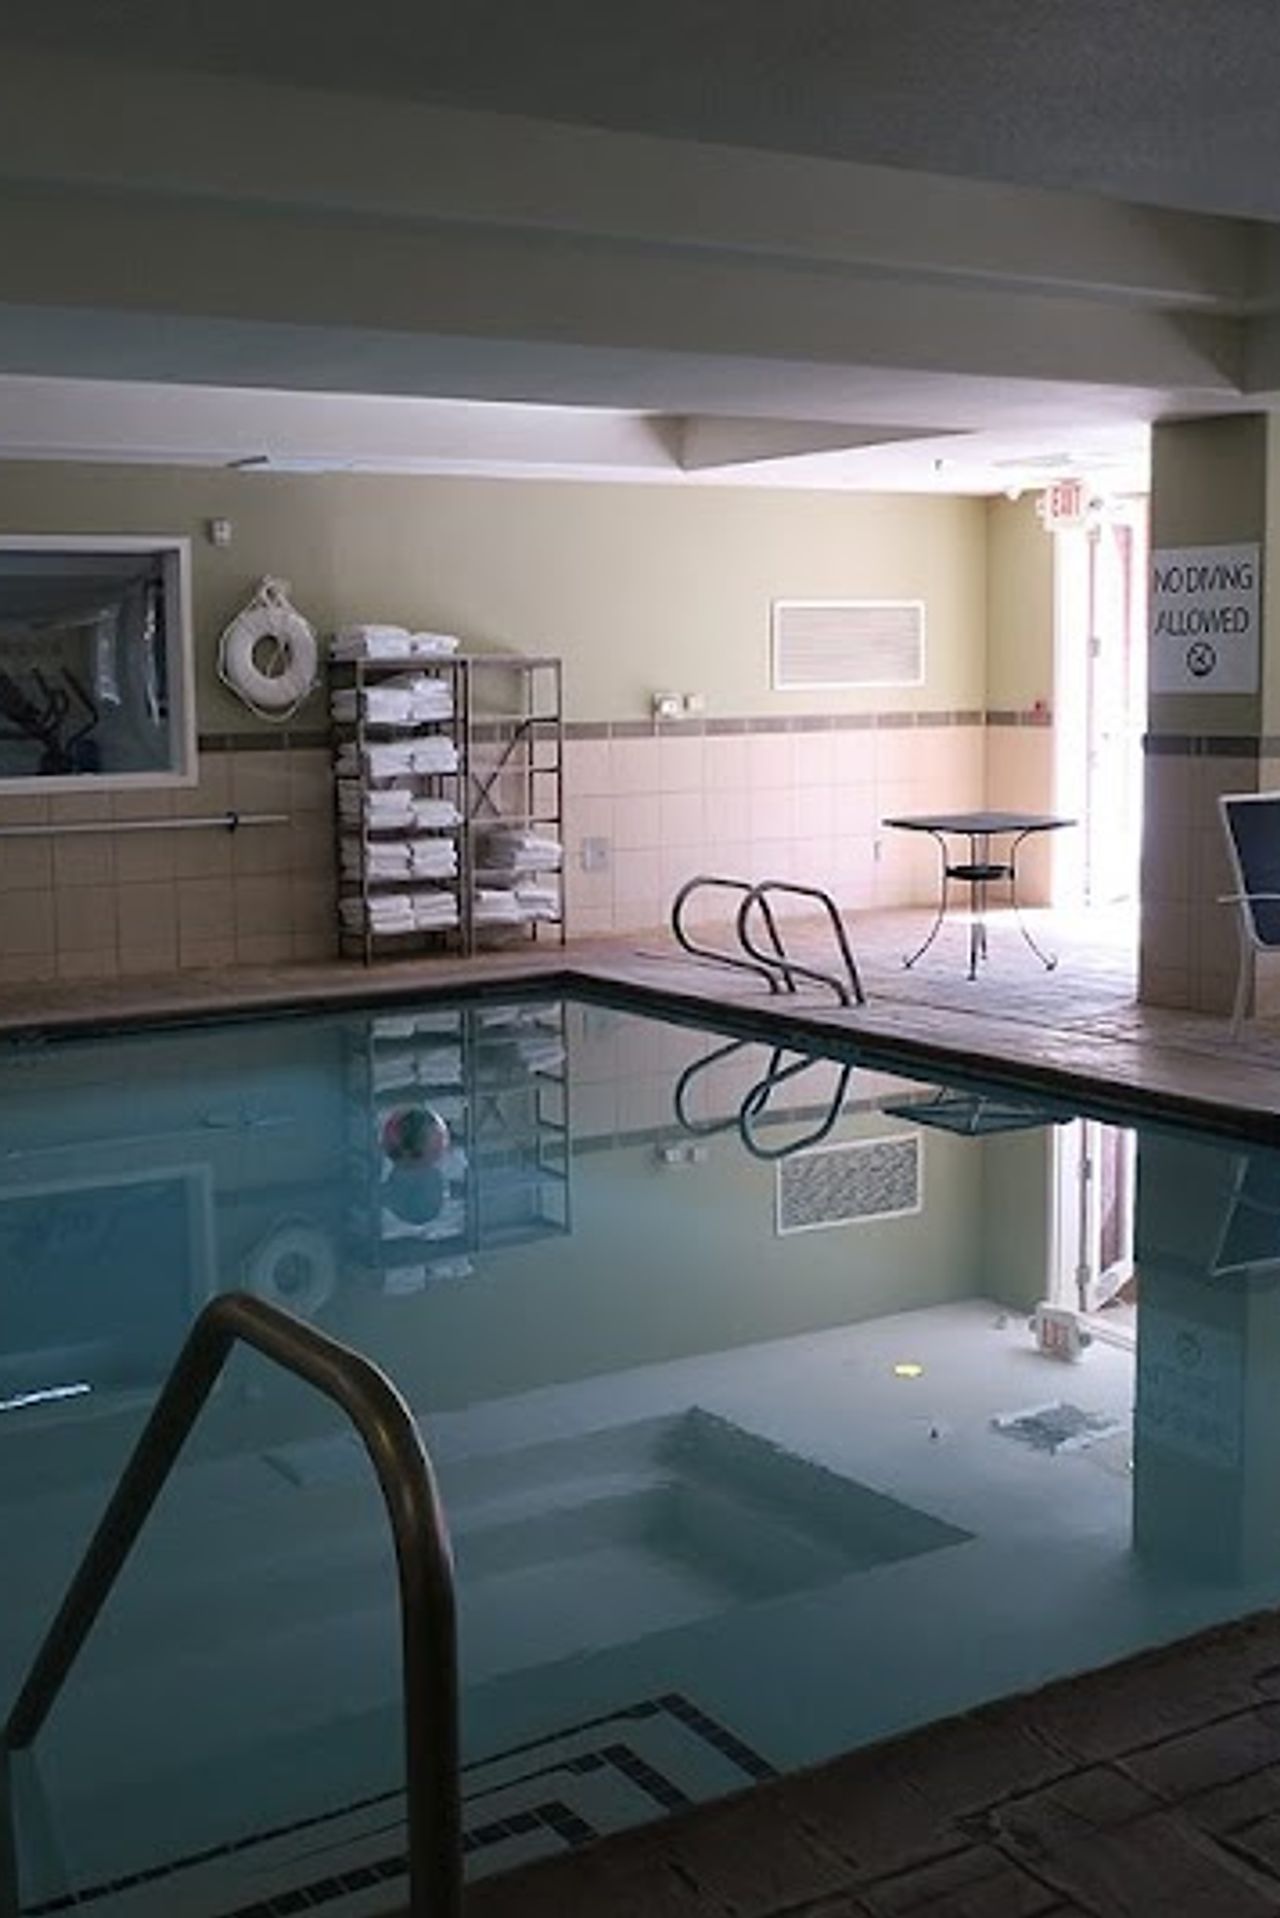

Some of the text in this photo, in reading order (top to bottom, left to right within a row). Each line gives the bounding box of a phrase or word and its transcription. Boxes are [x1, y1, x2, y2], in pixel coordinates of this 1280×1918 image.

[1050, 484, 1082, 518] EXIT
[1153, 563, 1253, 594] NO DIVING
[1154, 606, 1250, 637] ALLOWED
